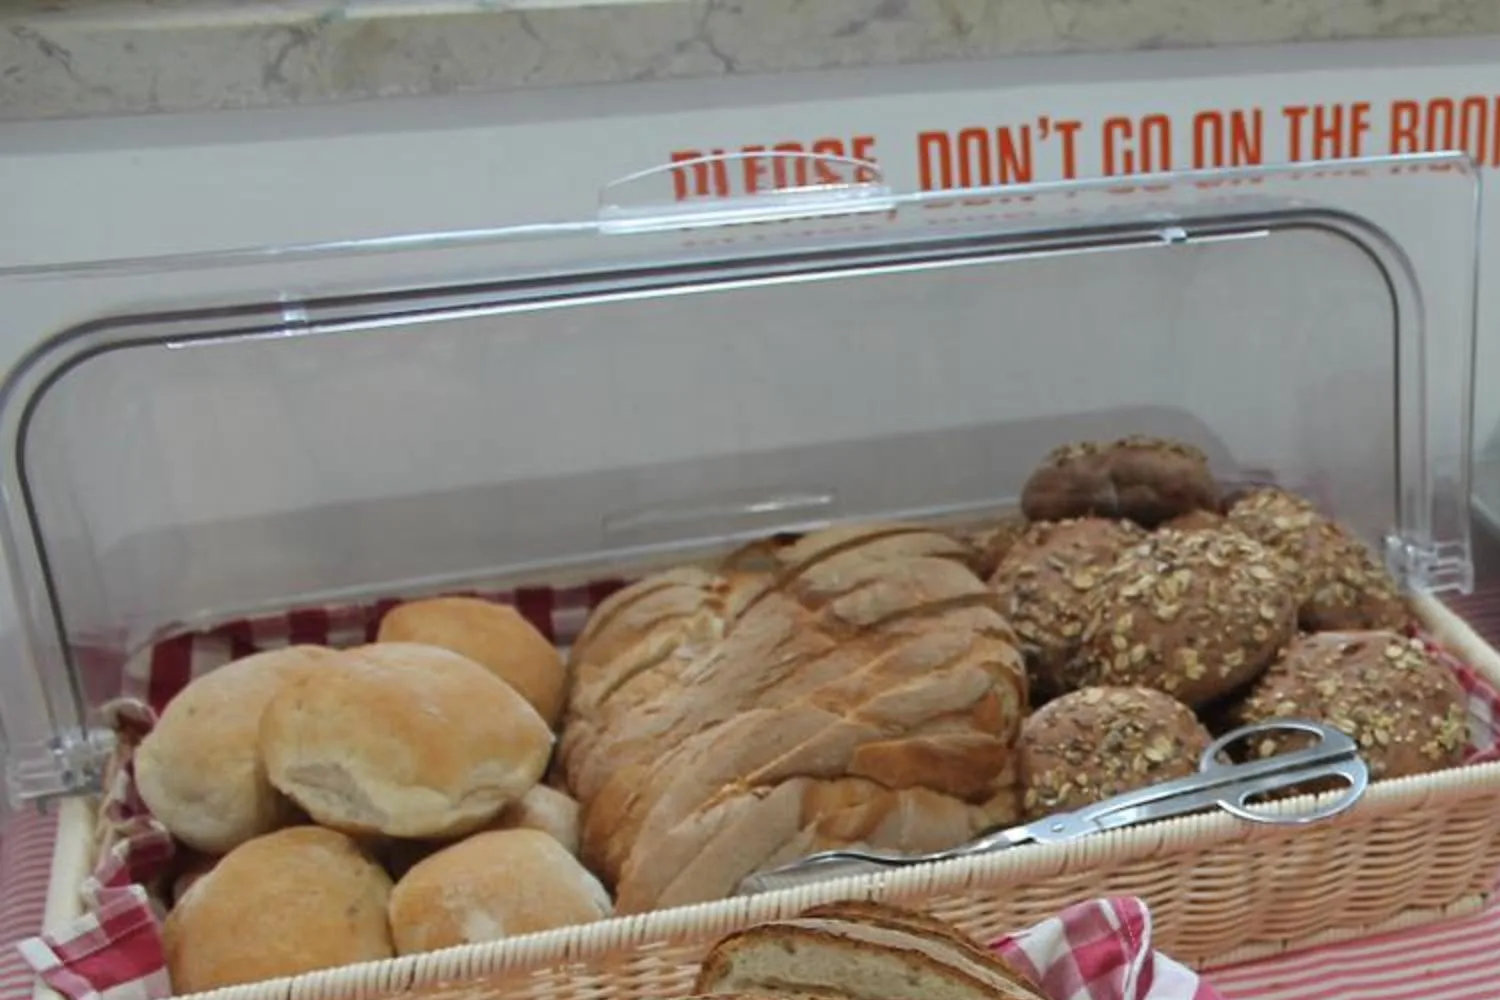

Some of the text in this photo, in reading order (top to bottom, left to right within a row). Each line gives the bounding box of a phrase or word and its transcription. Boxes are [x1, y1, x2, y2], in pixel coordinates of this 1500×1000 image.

[918, 117, 1081, 207] DON'T
[1101, 115, 1172, 193] GO
[1192, 108, 1264, 188] ON
[1282, 101, 1371, 178] THE
